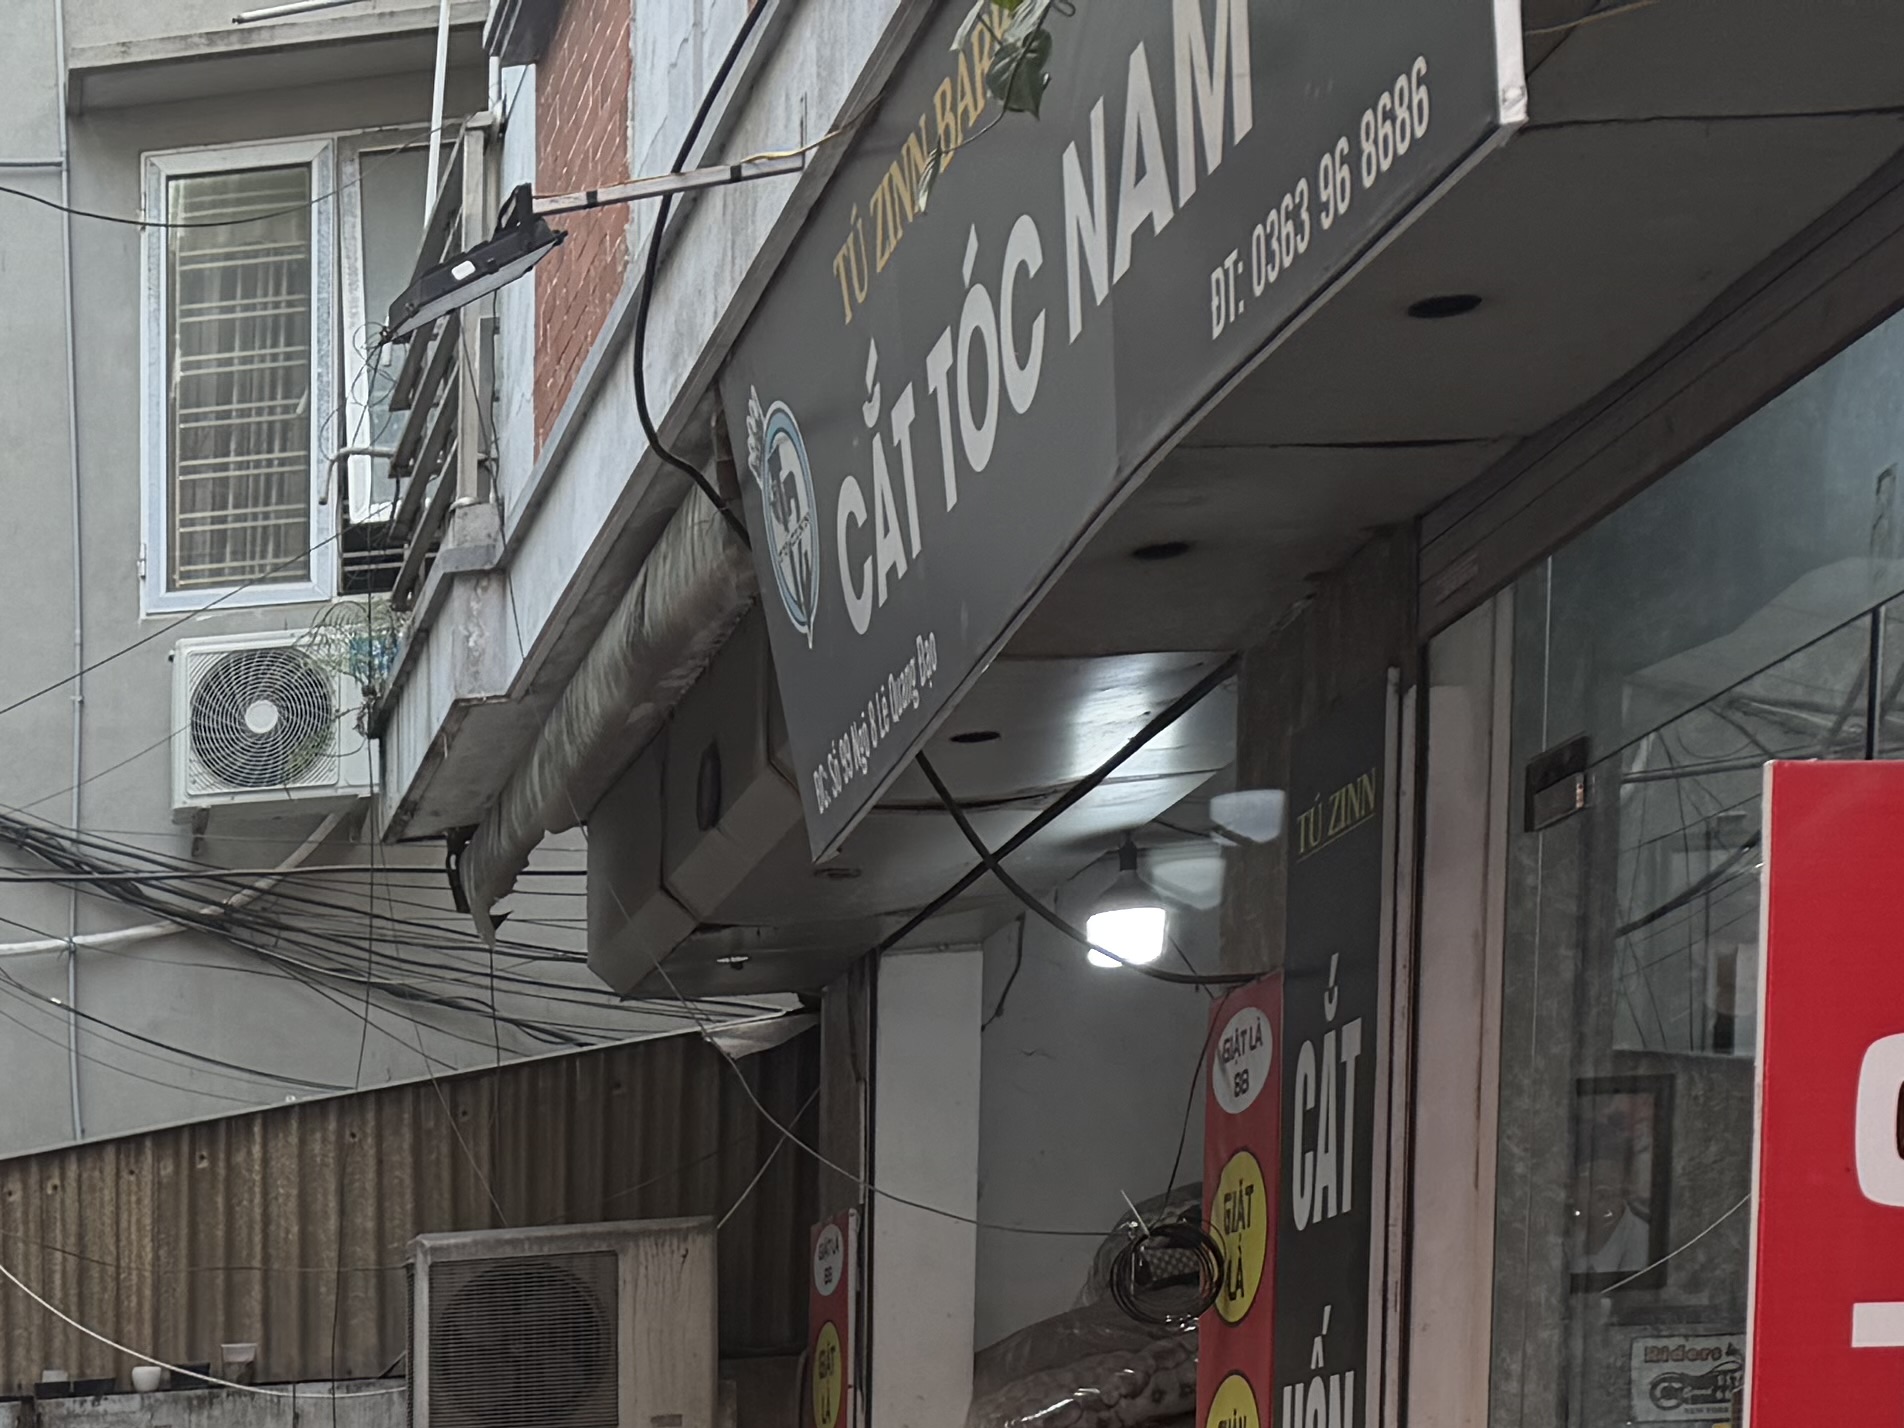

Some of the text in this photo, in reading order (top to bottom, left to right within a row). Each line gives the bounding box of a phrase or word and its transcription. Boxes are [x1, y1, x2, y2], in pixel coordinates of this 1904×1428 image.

[833, 203, 868, 325] TÚ
[1211, 56, 1431, 339] ĐT: 0363 96 8686
[837, 0, 1253, 634] CẮT TÓC NAM
[1297, 768, 1375, 856] TÚ ZINN
[1234, 1069, 1249, 1098] 88
[1292, 953, 1361, 1231] CẮT
